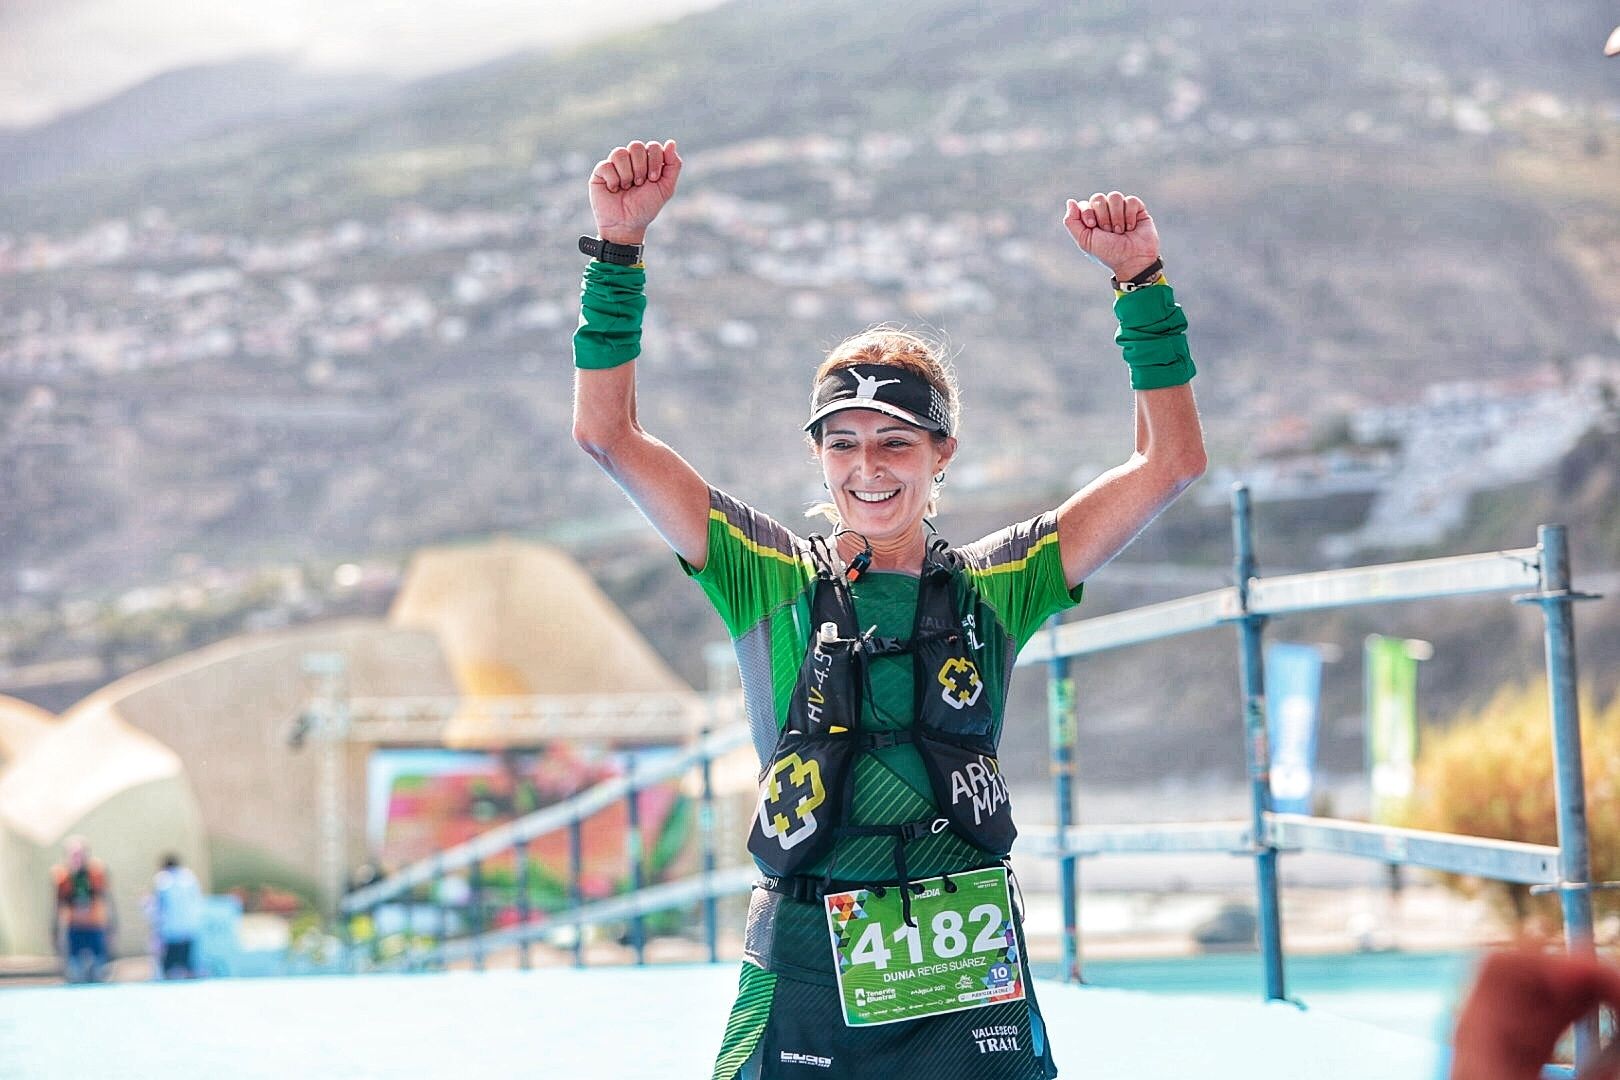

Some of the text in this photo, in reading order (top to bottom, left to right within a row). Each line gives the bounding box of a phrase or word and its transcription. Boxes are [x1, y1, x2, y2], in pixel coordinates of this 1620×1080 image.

[851, 903, 1009, 970] 4182
[883, 970, 916, 983] DUNIA
[917, 962, 949, 976] REYES
[990, 966, 1008, 980] 10
[971, 1025, 1018, 1039] VALLESECO
[975, 1037, 1021, 1054] TRAIL
